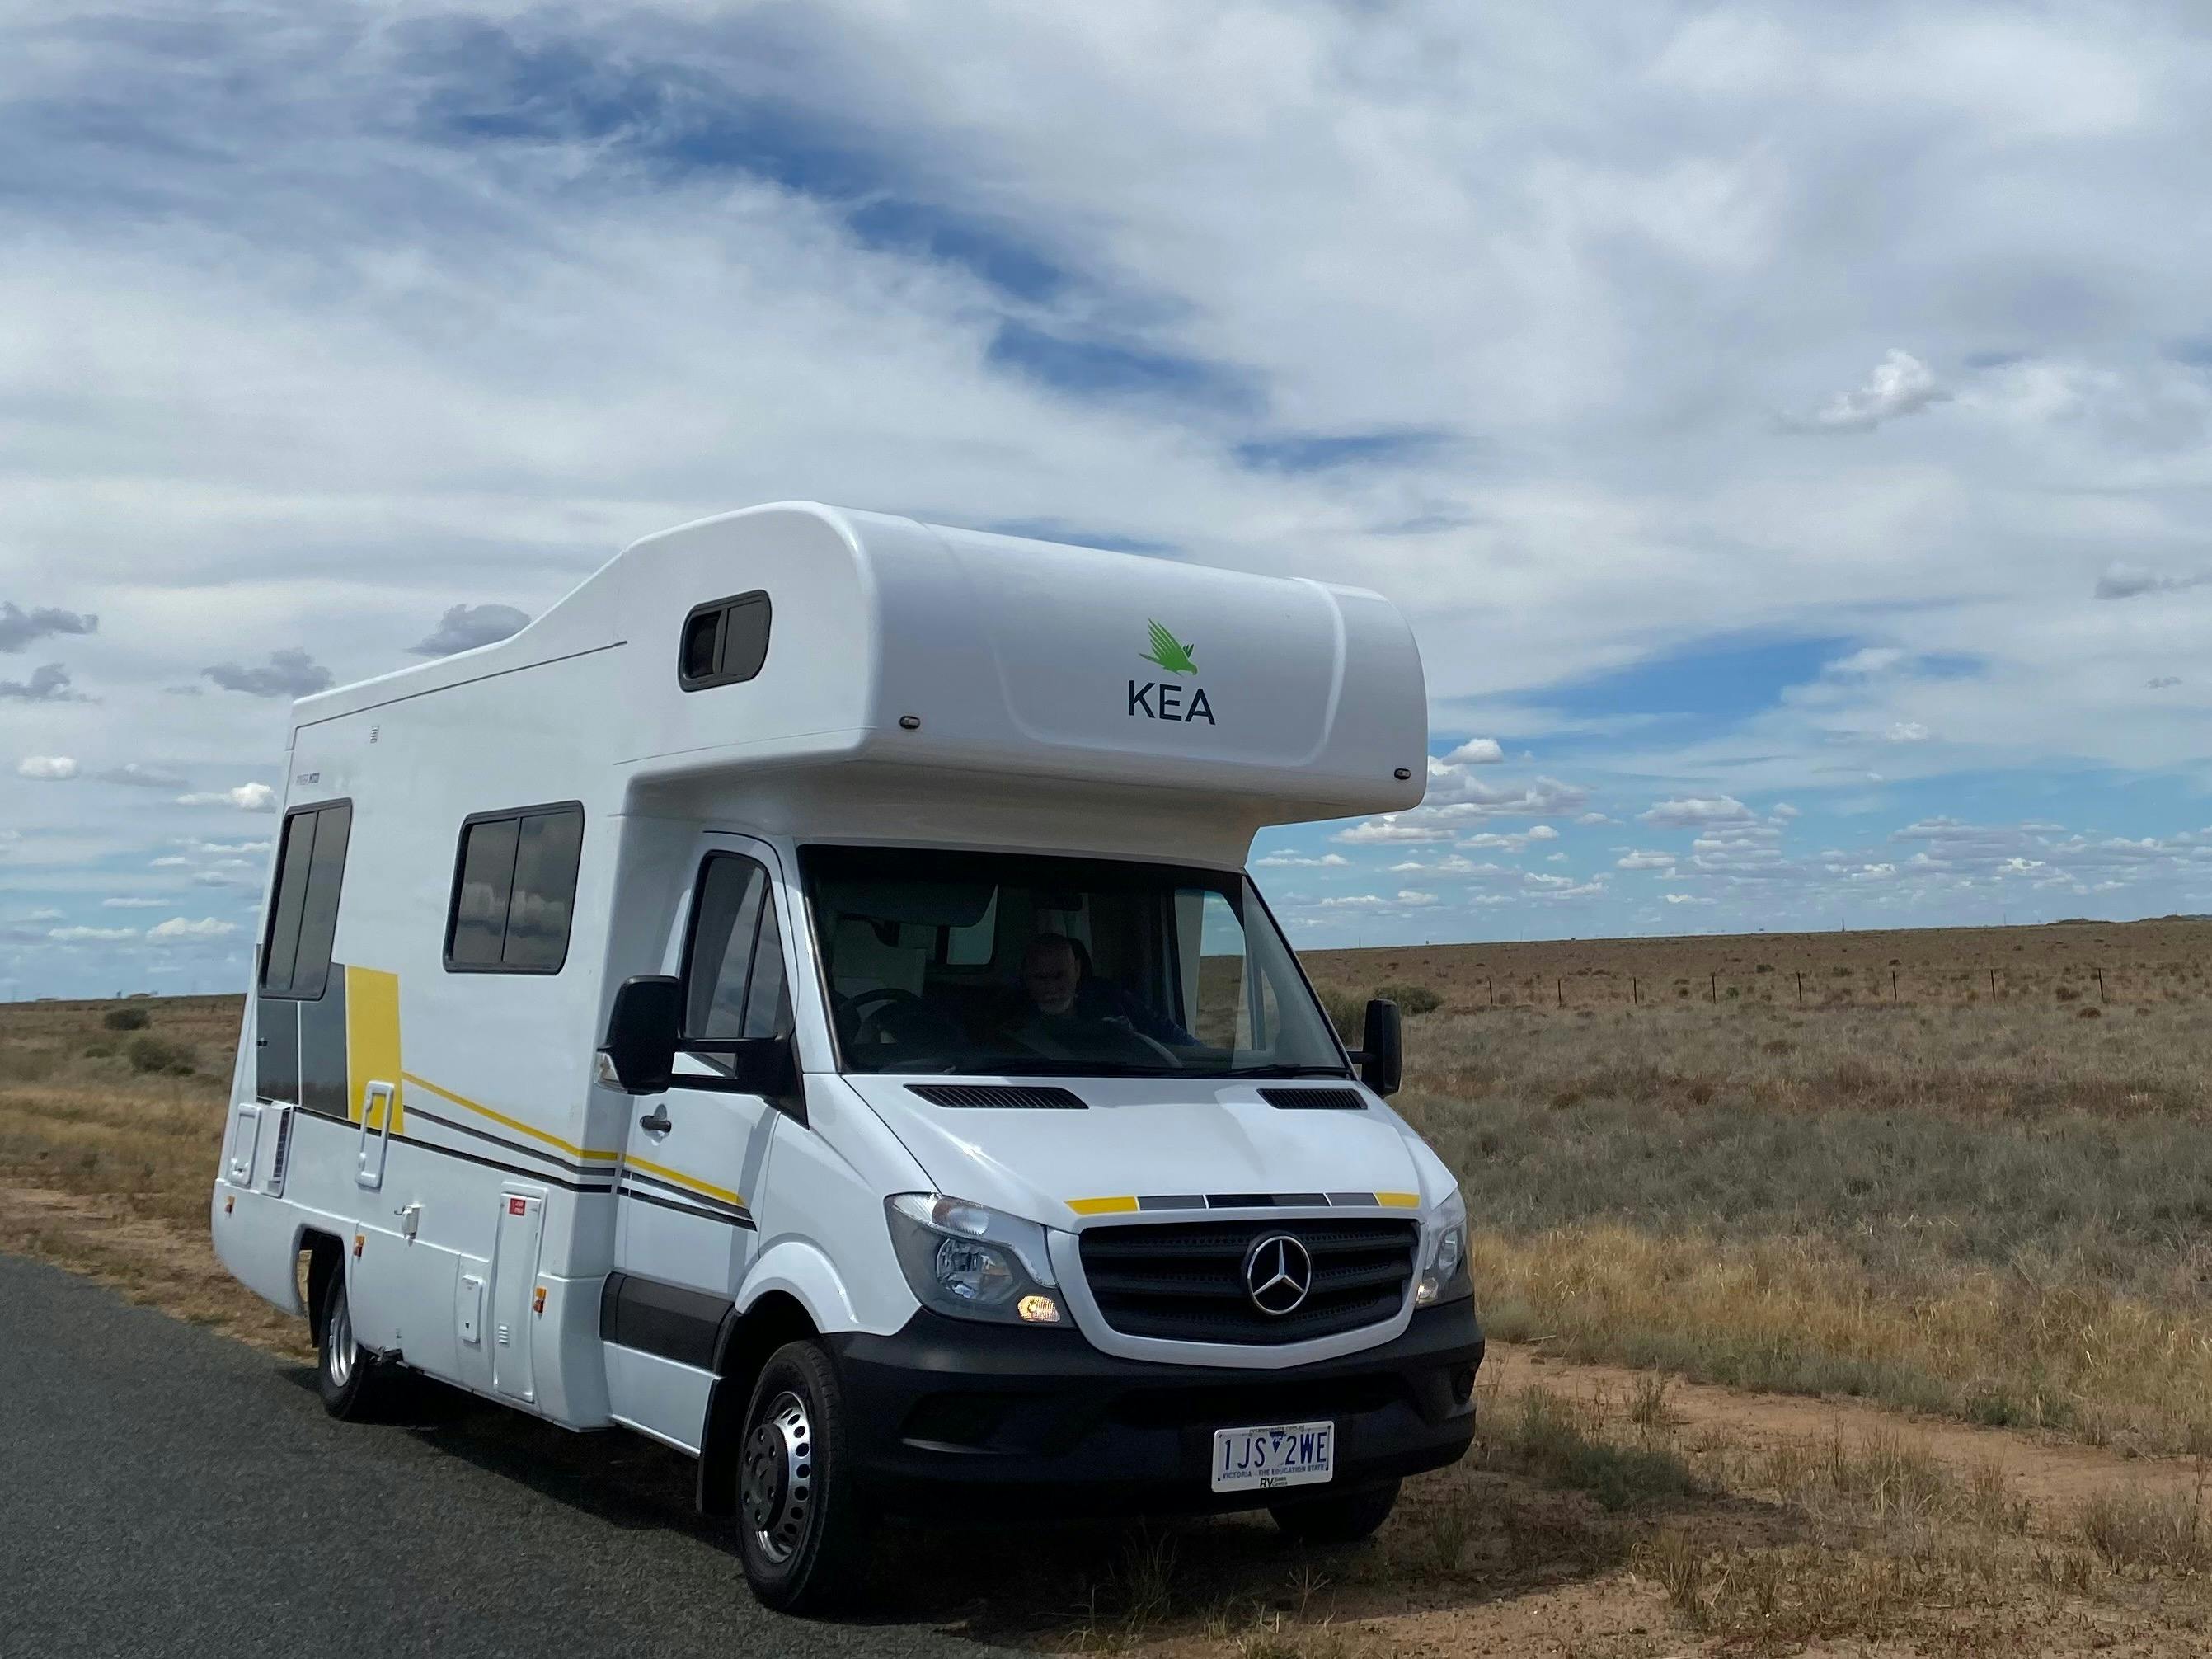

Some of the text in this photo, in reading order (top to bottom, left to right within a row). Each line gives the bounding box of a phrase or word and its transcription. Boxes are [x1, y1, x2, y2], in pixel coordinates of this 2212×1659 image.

[1128, 679, 1216, 726] KEA
[1224, 1432, 1327, 1470] 1JS 2WE
[1222, 1470, 1252, 1479] VICTORIA
[1271, 1465, 1306, 1475] EDUCATION
[1307, 1464, 1324, 1472] STATE
[1260, 1477, 1274, 1488] RV
